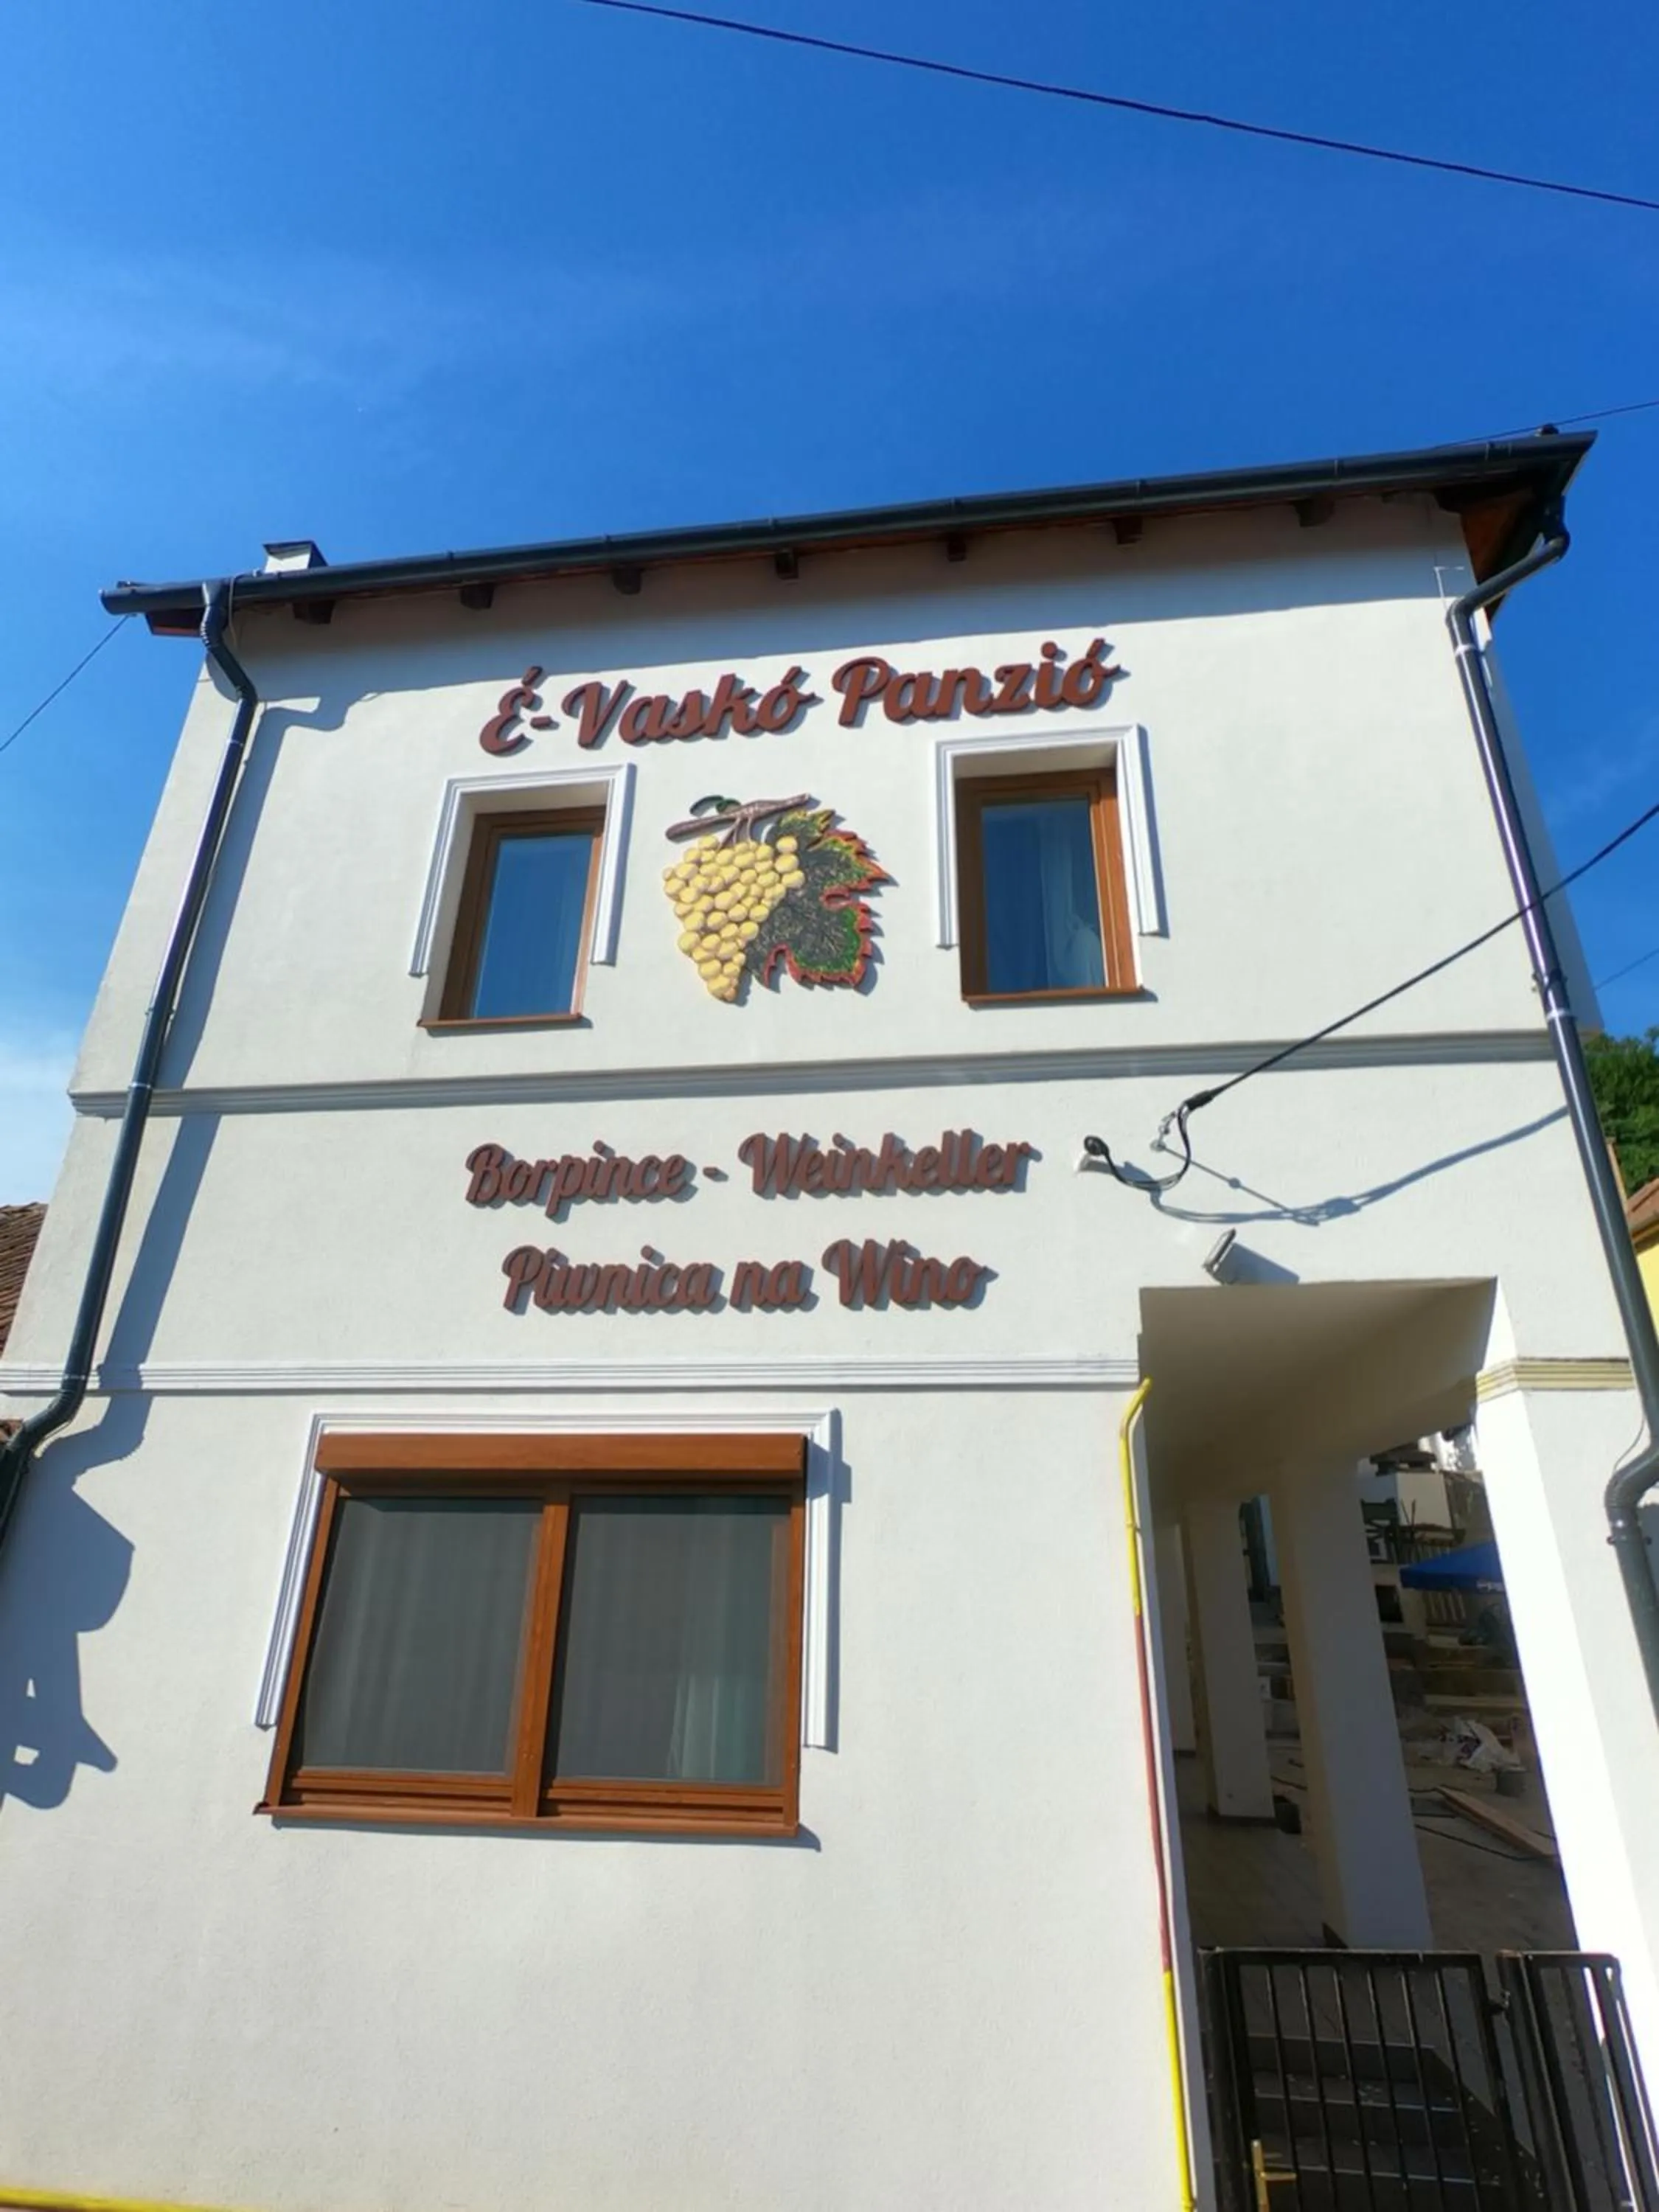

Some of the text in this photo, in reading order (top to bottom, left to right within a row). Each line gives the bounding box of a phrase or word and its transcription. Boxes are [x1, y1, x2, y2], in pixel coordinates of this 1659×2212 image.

[832, 637, 1120, 727] Panzió
[465, 1140, 688, 1217] Borpince
[738, 1129, 1032, 1195] Weinkeller
[728, 1260, 808, 1308] na
[821, 1238, 990, 1307] Wino
